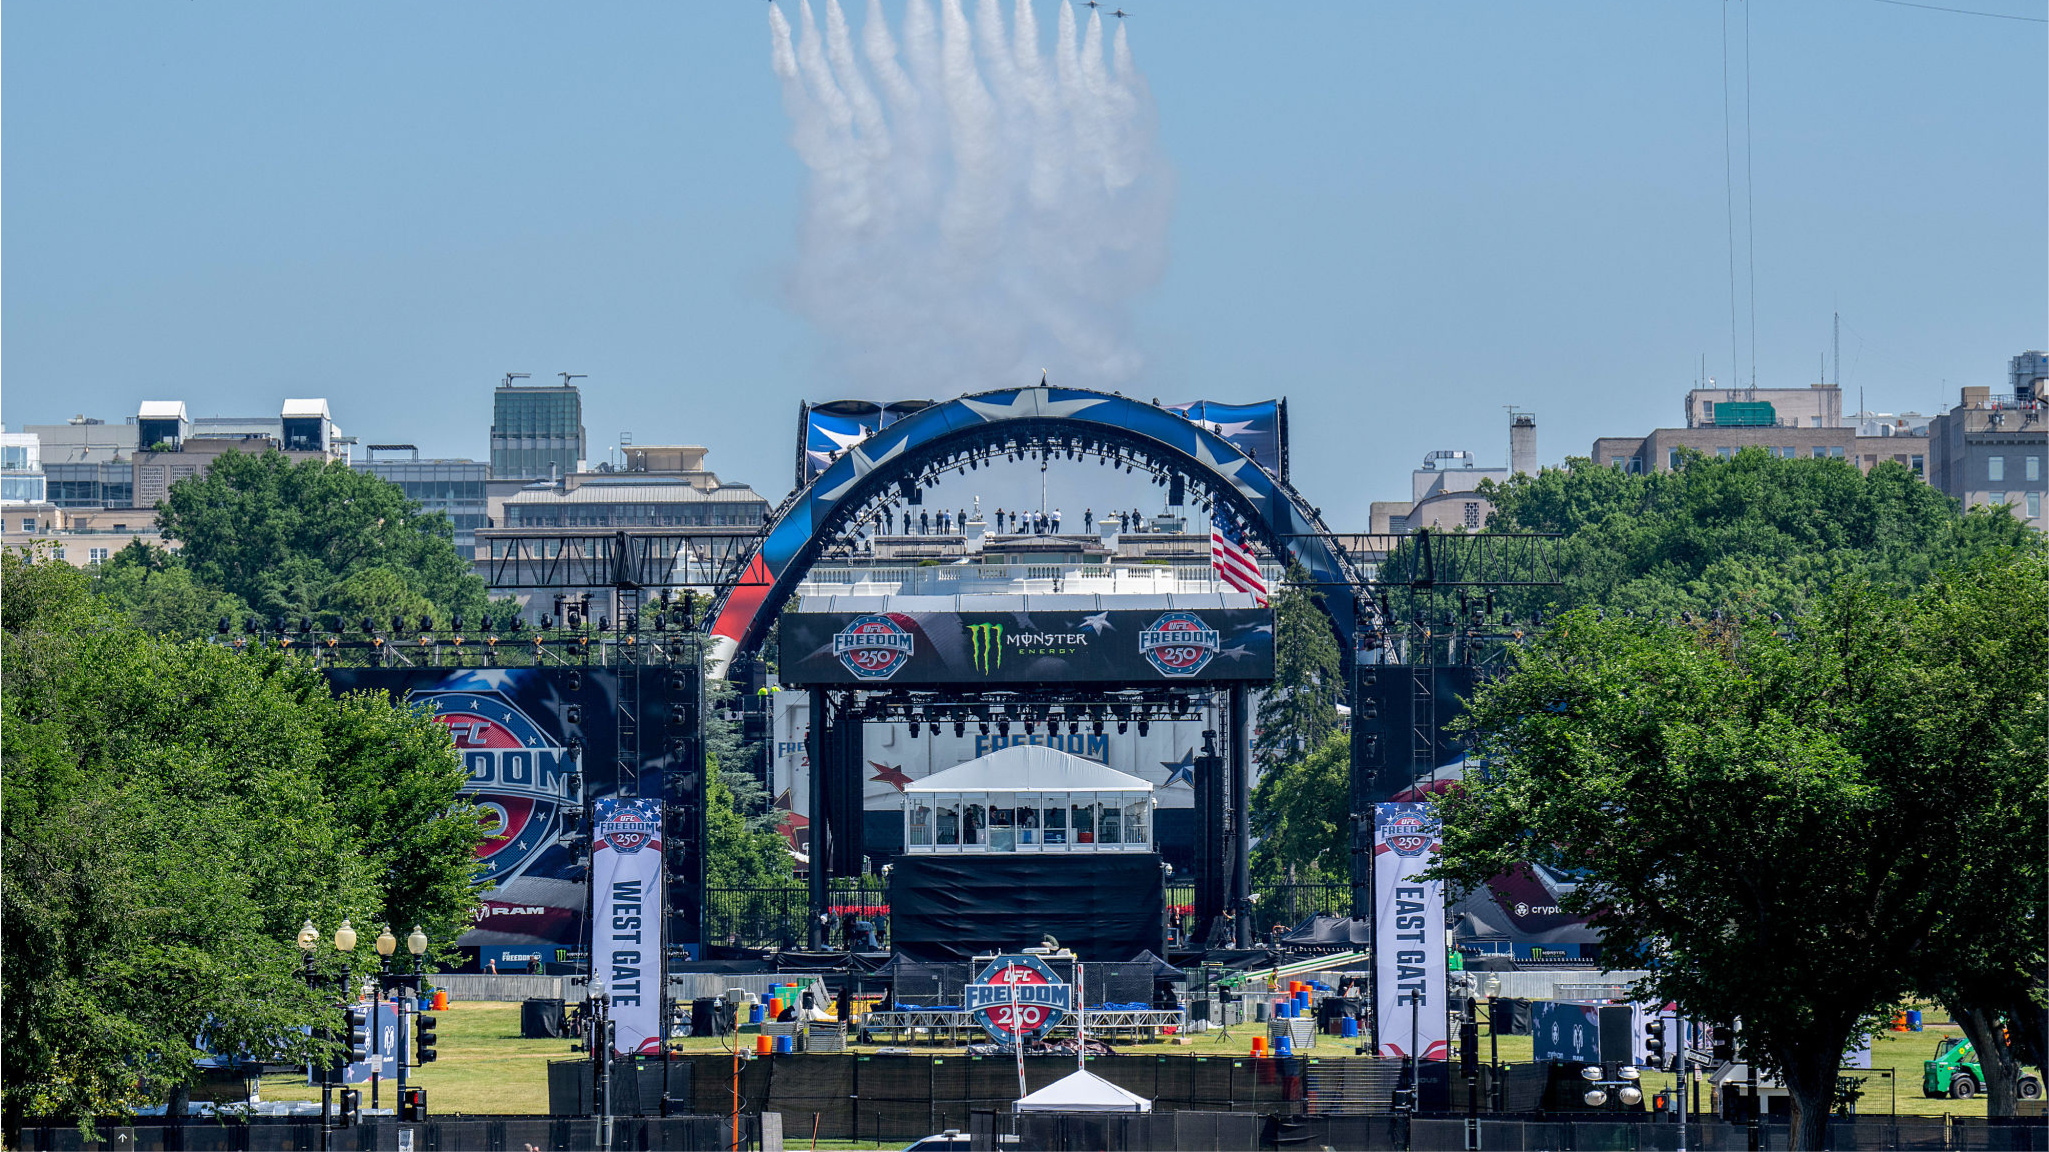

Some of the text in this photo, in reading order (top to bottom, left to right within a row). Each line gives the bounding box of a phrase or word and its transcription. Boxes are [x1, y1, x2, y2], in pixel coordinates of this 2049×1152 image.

[1169, 622, 1189, 630] UFC
[835, 634, 912, 652] FREEDOM
[1007, 632, 1088, 647] MONSTER
[1141, 632, 1217, 648] FREEDOM
[859, 650, 890, 667] 250
[1164, 648, 1196, 664] 250
[601, 822, 655, 834] FREEDOM
[617, 834, 639, 846] 250
[1398, 838, 1420, 849] 250
[612, 880, 642, 1007] WEST GATE
[1396, 887, 1426, 1006] EAST GATE
